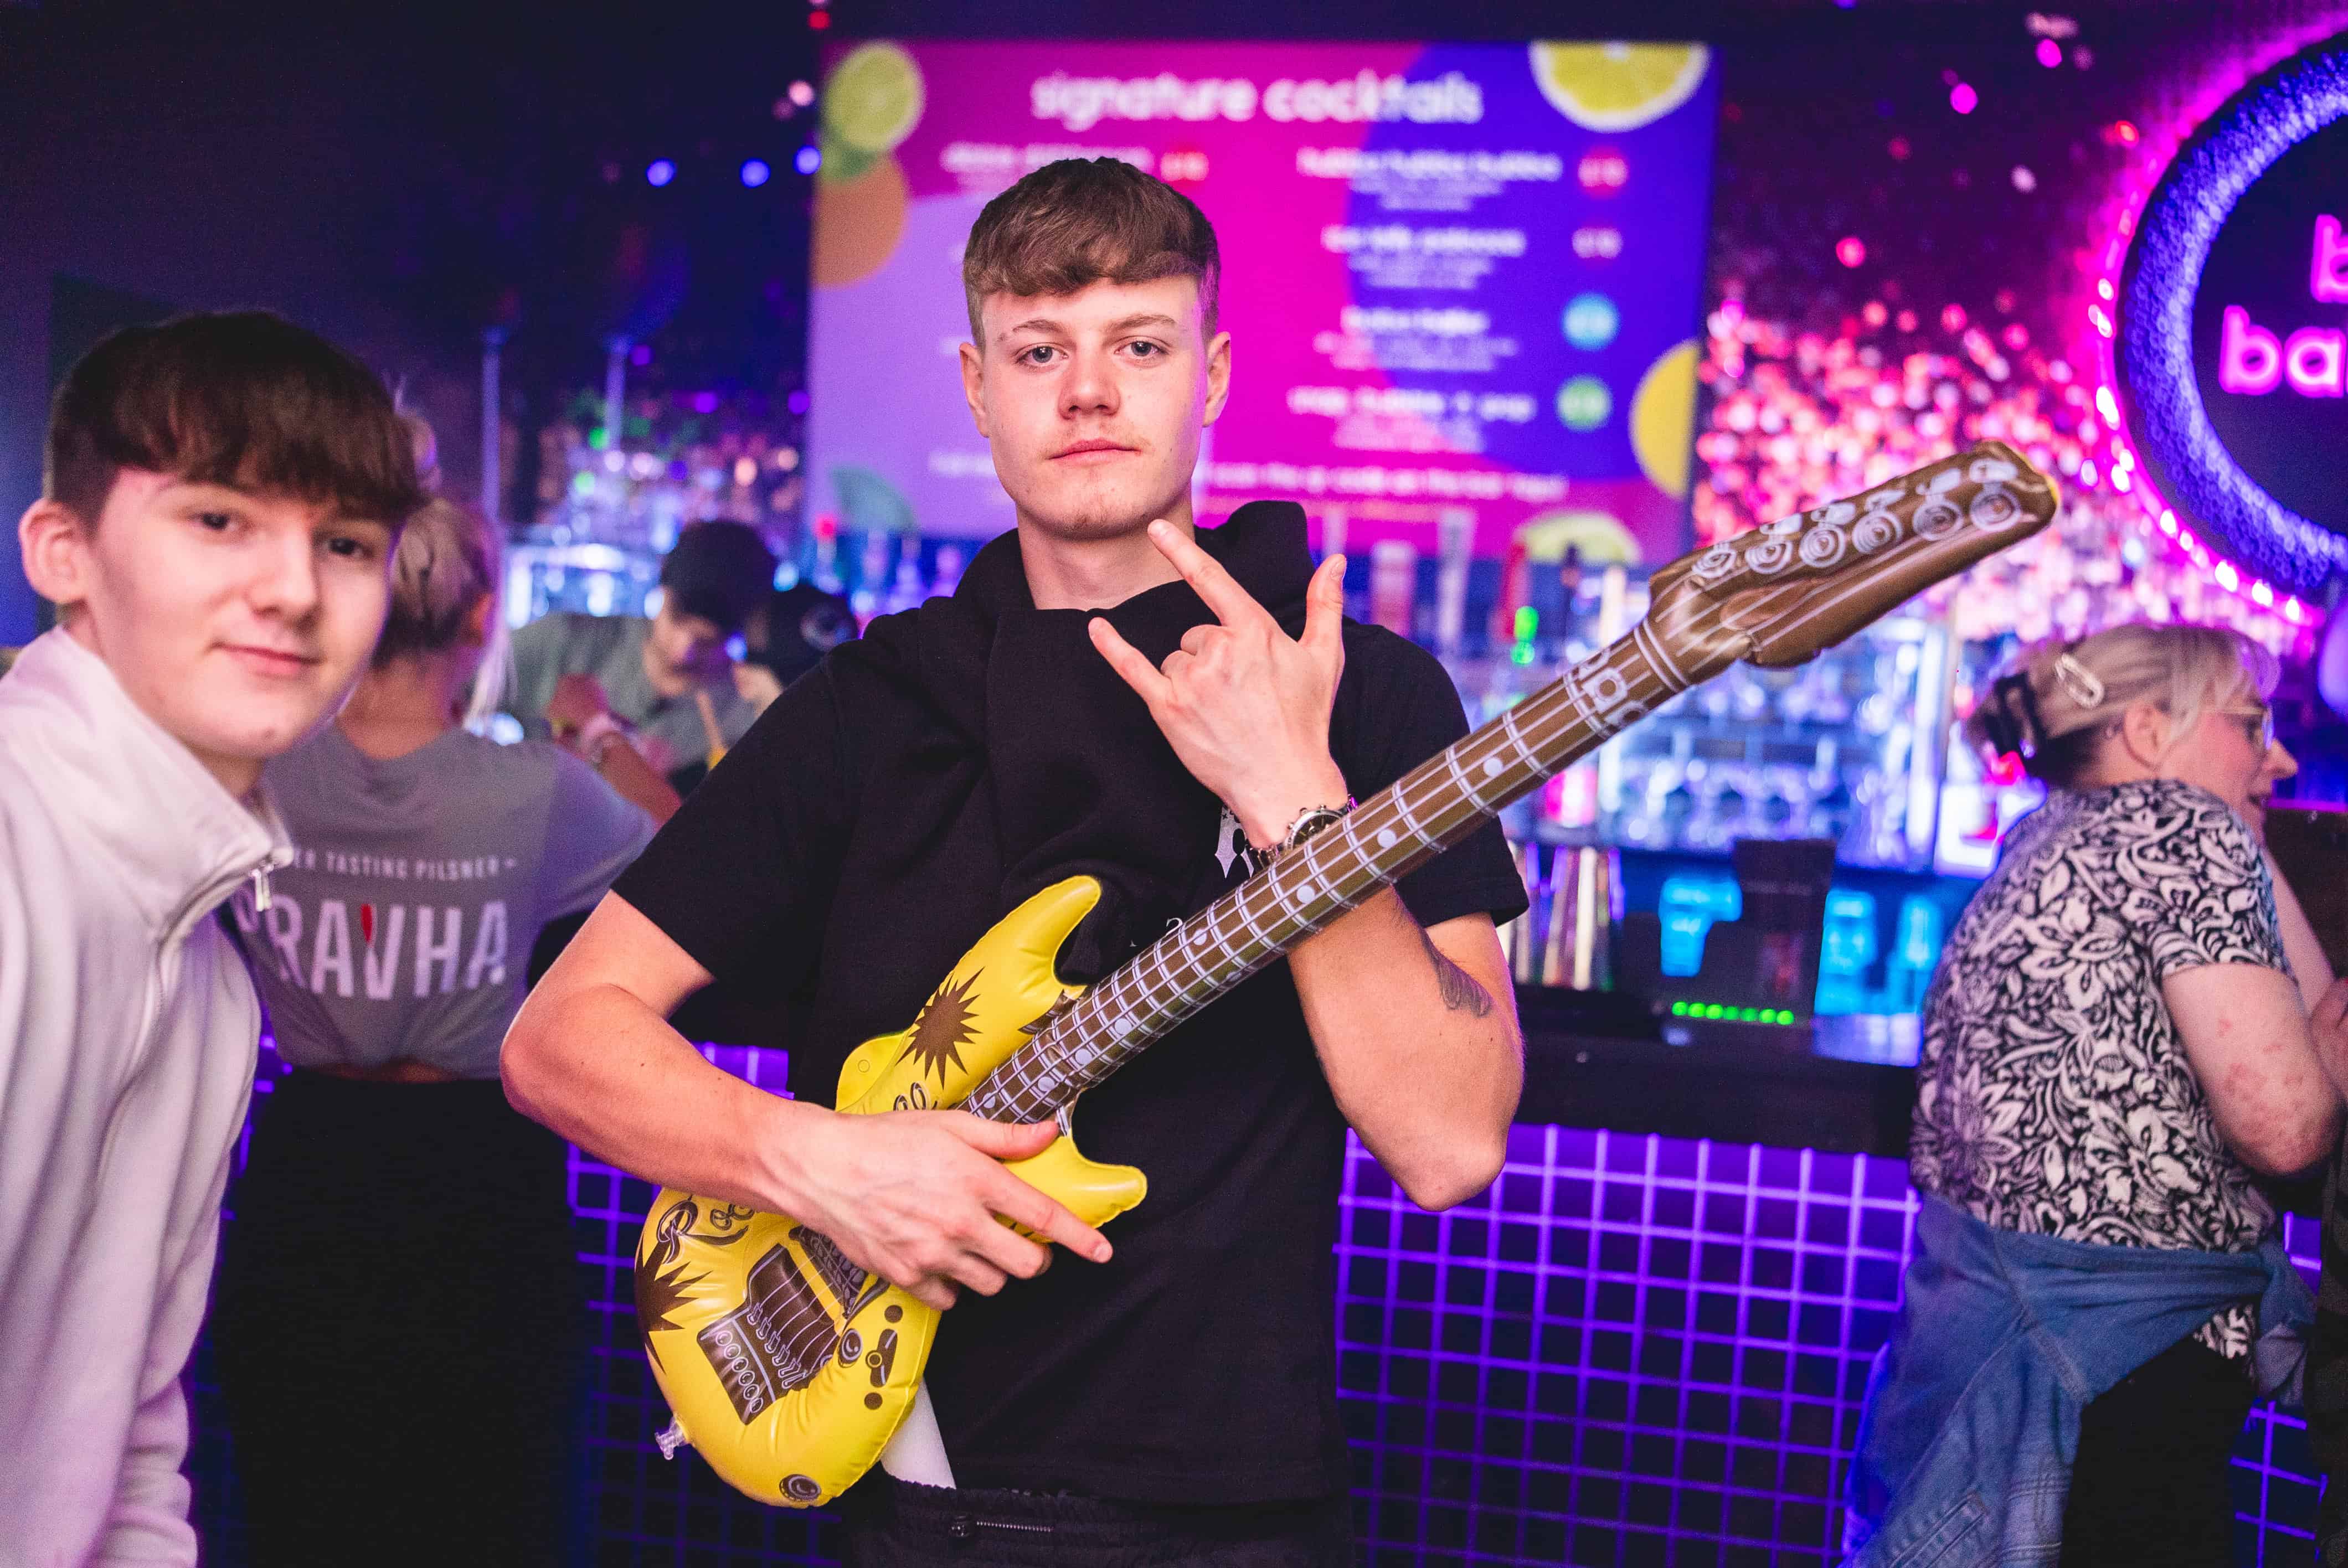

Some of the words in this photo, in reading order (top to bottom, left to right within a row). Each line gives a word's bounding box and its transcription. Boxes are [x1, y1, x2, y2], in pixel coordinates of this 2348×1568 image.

[1032, 70, 1257, 132] signature
[1264, 69, 1483, 123] cocktails
[2219, 305, 2348, 398] ba
[327, 849, 408, 880] TASTING
[415, 855, 498, 881] PILSNER
